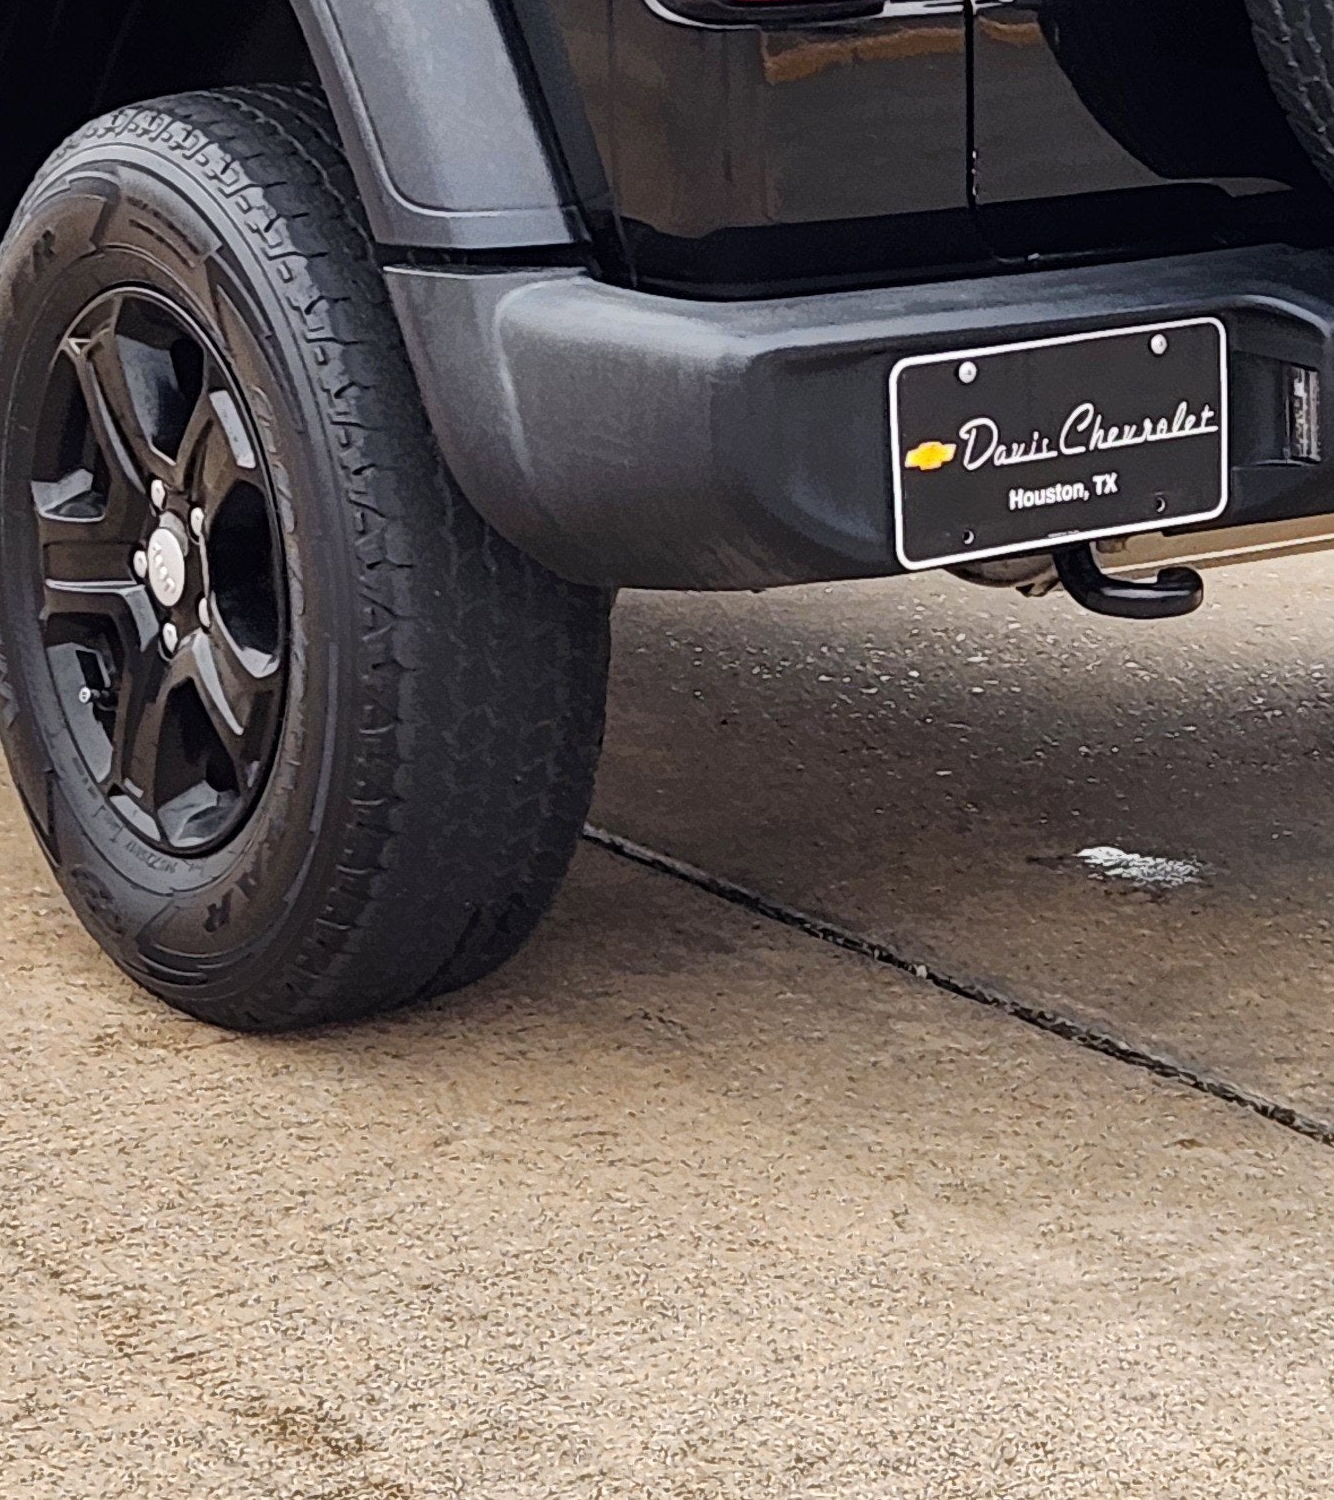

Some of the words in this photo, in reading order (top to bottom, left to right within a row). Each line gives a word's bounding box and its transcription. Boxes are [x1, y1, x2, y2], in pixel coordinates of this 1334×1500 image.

[959, 417, 1057, 470] Davis
[1059, 402, 1218, 456] Chevrolet
[1009, 482, 1090, 510] Houston,
[1092, 472, 1119, 497] TX
